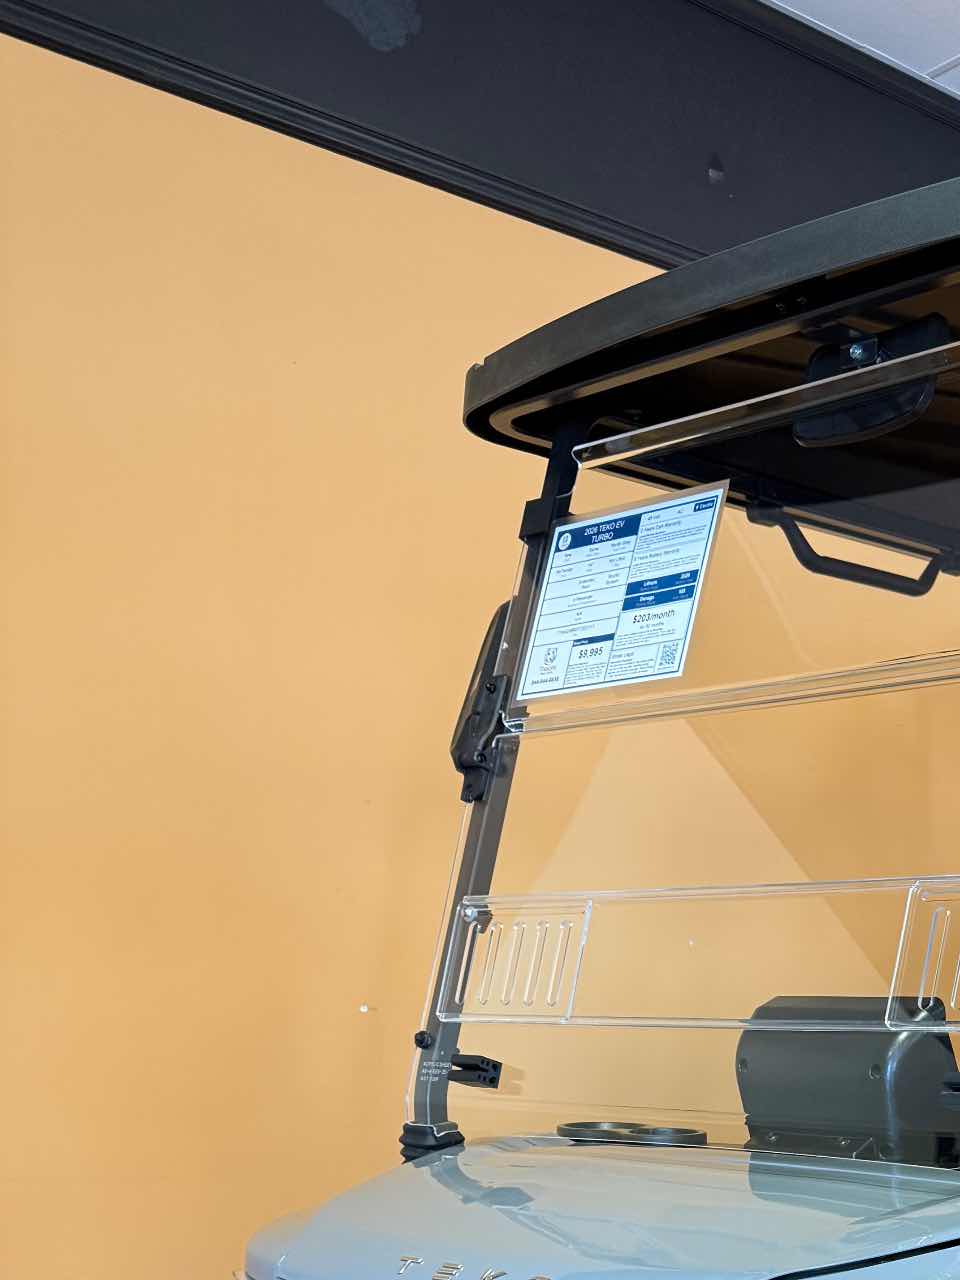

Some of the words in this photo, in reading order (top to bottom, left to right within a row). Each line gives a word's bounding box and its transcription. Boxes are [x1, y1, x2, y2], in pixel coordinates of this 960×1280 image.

[584, 526, 598, 536] 2026
[599, 522, 615, 532] TEKO
[615, 520, 626, 529] EV
[591, 532, 614, 543] TURBO
[633, 609, 675, 624] $203/month
[578, 647, 603, 659] $9,995
